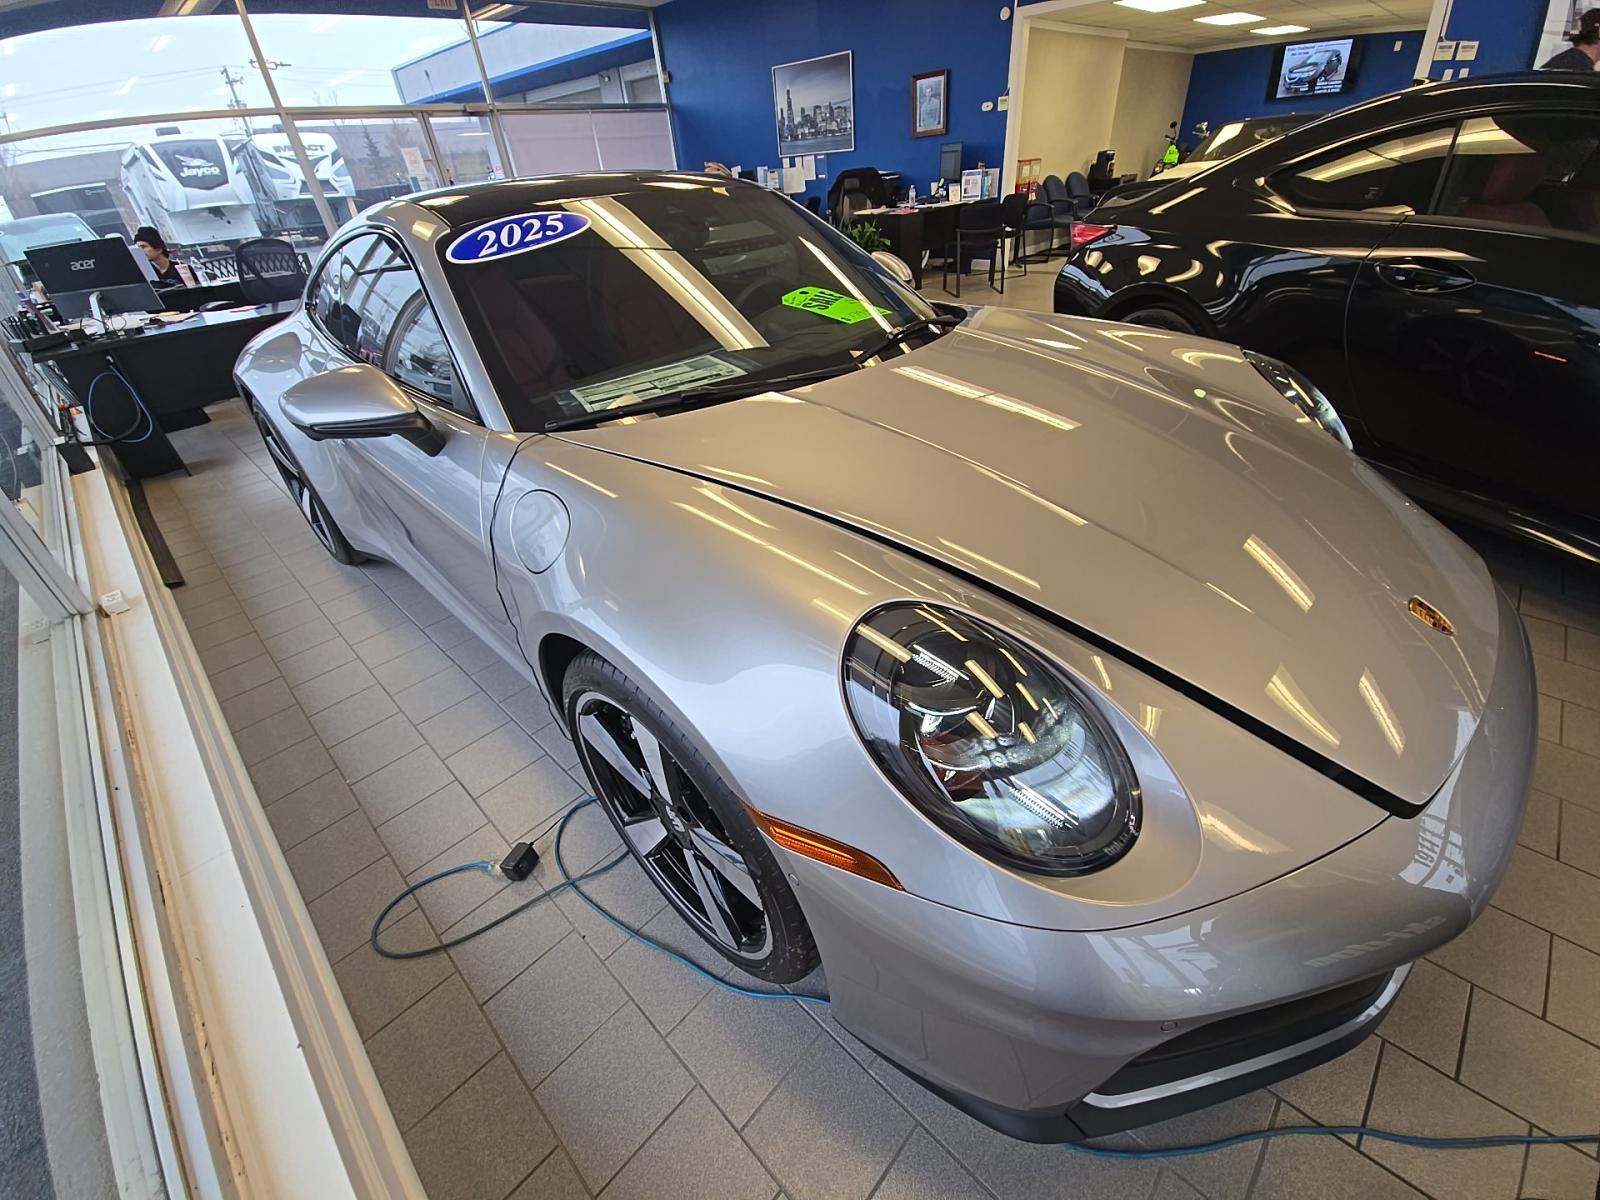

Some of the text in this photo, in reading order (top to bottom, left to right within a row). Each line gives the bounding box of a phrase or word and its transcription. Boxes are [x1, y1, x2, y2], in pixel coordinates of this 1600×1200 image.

[180, 166, 220, 178] Jayco
[477, 213, 564, 258] 2025
[70, 259, 96, 271] acer
